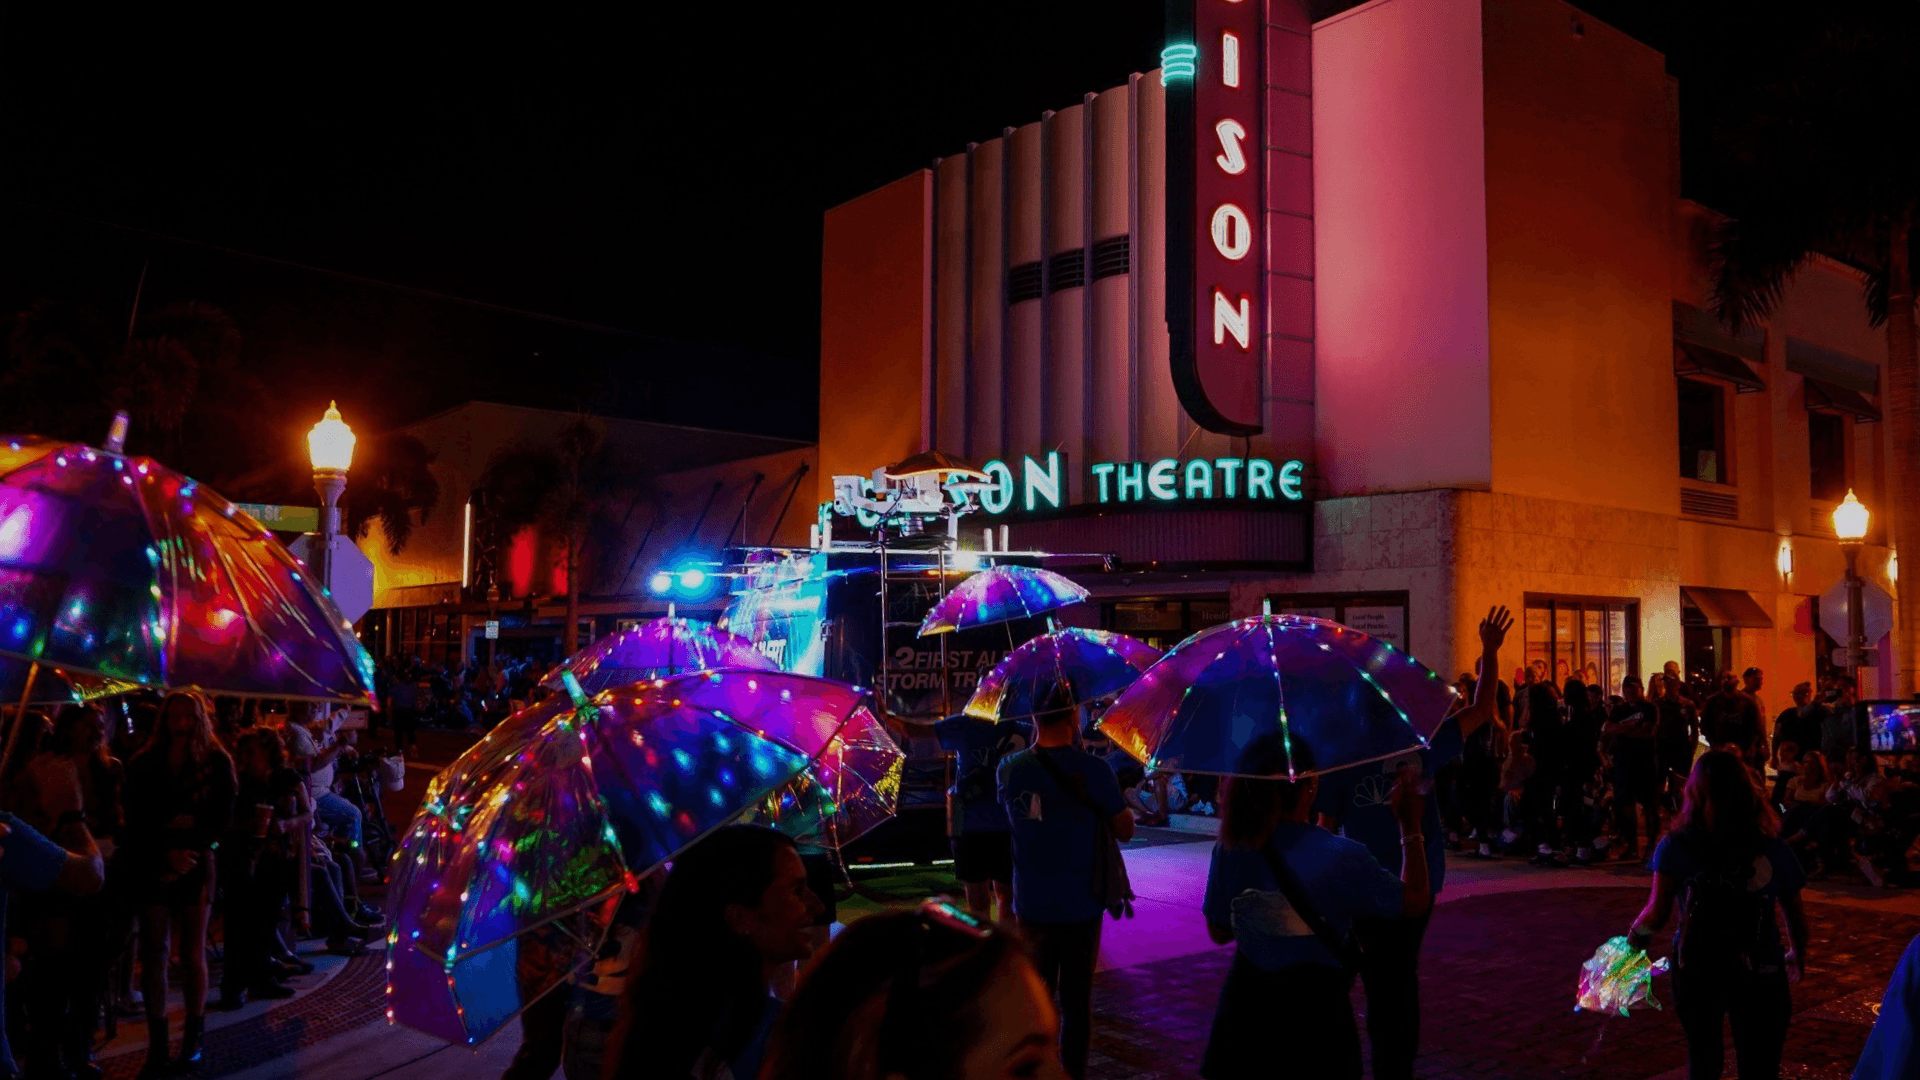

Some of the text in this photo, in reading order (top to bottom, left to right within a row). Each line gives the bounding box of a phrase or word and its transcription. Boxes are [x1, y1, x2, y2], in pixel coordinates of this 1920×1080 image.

[1211, 0, 1251, 349] ISON
[1092, 458, 1303, 503] THEATRE
[1202, 610, 1230, 621] Hendr
[876, 672, 945, 690] STORM
